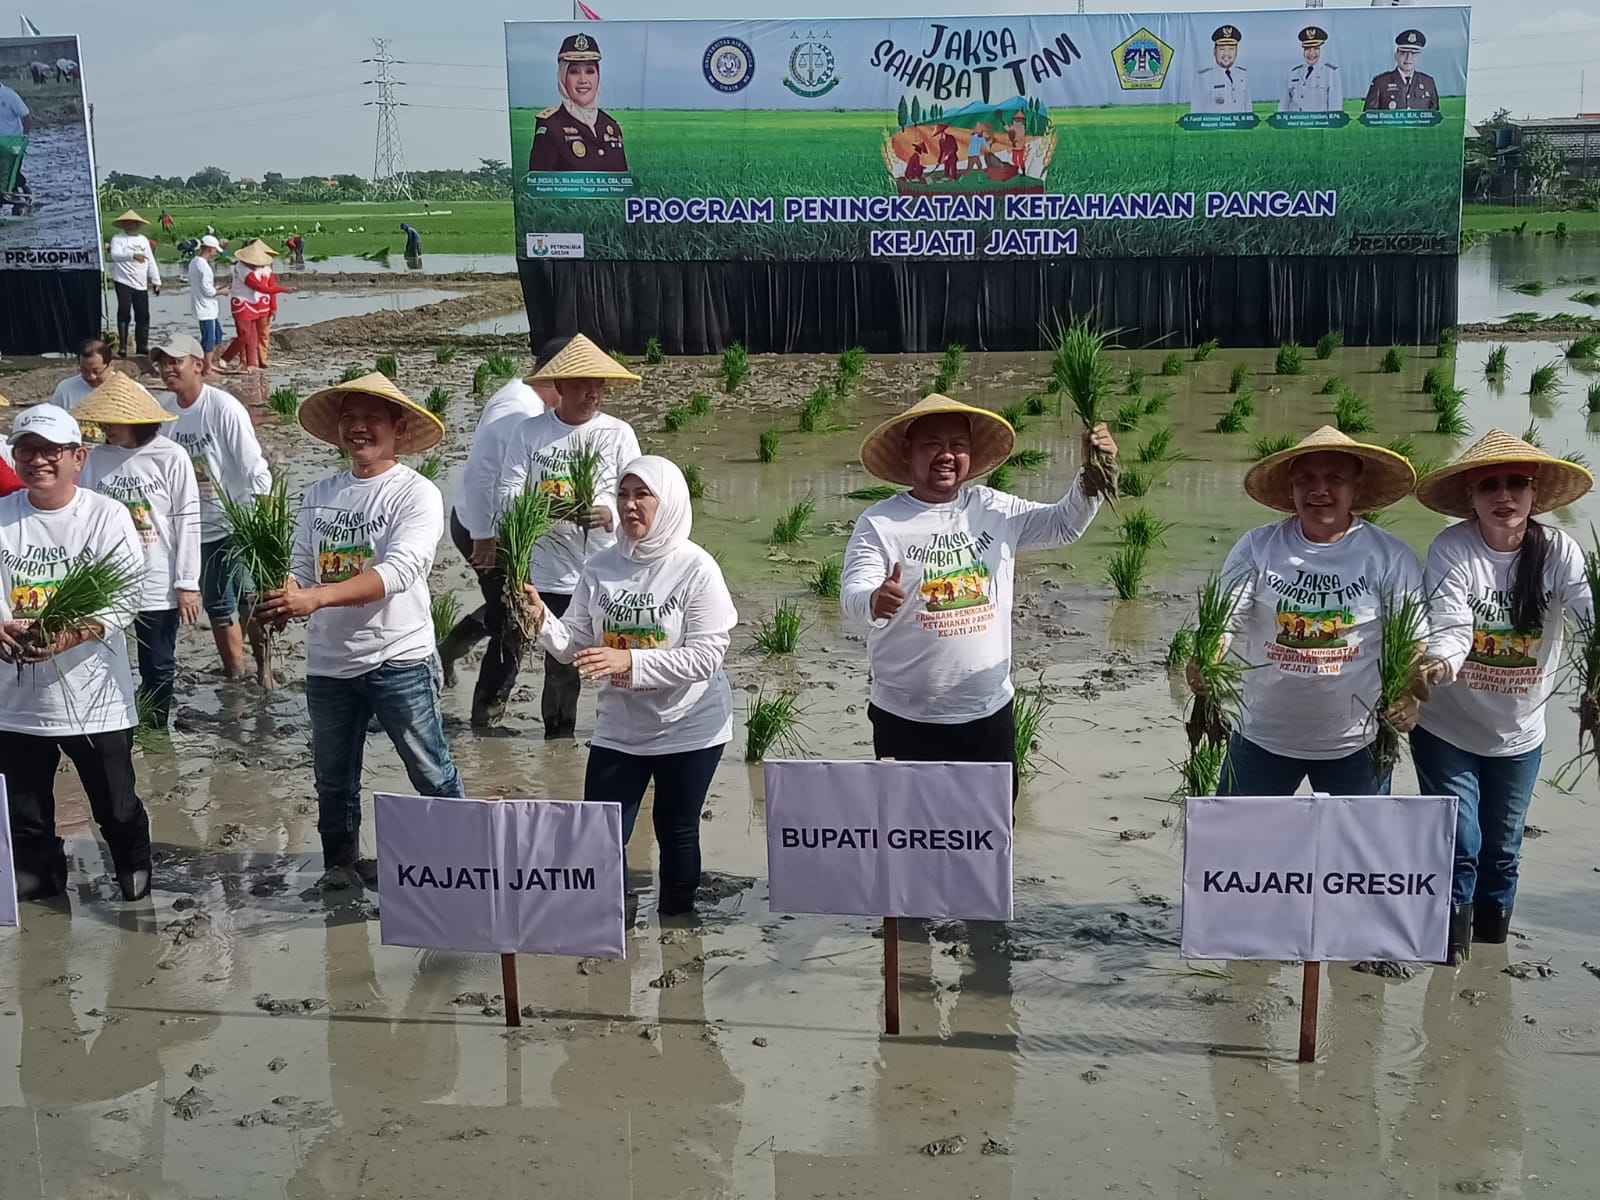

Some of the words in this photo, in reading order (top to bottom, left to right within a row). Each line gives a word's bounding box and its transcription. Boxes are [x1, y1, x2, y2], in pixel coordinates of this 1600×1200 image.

[922, 24, 1017, 66] JAKSA
[870, 39, 998, 104] SAHABAT
[1003, 32, 1082, 96] TANI
[625, 197, 774, 222] PROGRAM
[784, 195, 995, 222] PENINGKATAN
[1004, 192, 1196, 220] KETAHANAN
[1205, 190, 1337, 218] PANGAN
[870, 229, 975, 256] KEJATI
[984, 228, 1078, 255] JATIM
[5, 251, 89, 264] PROKOPIM
[531, 451, 573, 472] SAHABA
[330, 511, 365, 527] JAKSA
[359, 514, 388, 540] TANI
[22, 544, 67, 561] JAKSA
[906, 545, 962, 567] SAHABAT
[964, 530, 994, 560] TANI
[929, 531, 969, 550] JAKSA
[2, 549, 58, 578] SAHABAT
[1266, 574, 1330, 608] SAHABAT
[1333, 576, 1369, 605] TANI
[1291, 569, 1341, 591] JAKSA
[598, 594, 643, 625] SAHABAT
[646, 595, 679, 623] TANI
[614, 589, 654, 607] JAKSA
[938, 627, 966, 638] KEJATI
[1280, 663, 1310, 674] KEJATI
[782, 828, 878, 849] BUPATI
[887, 829, 994, 850] GRESIK
[398, 864, 499, 890] KAJATI
[509, 868, 595, 891] JATIM
[1203, 871, 1313, 894] KAJARI
[1323, 872, 1437, 895] GRESIK
